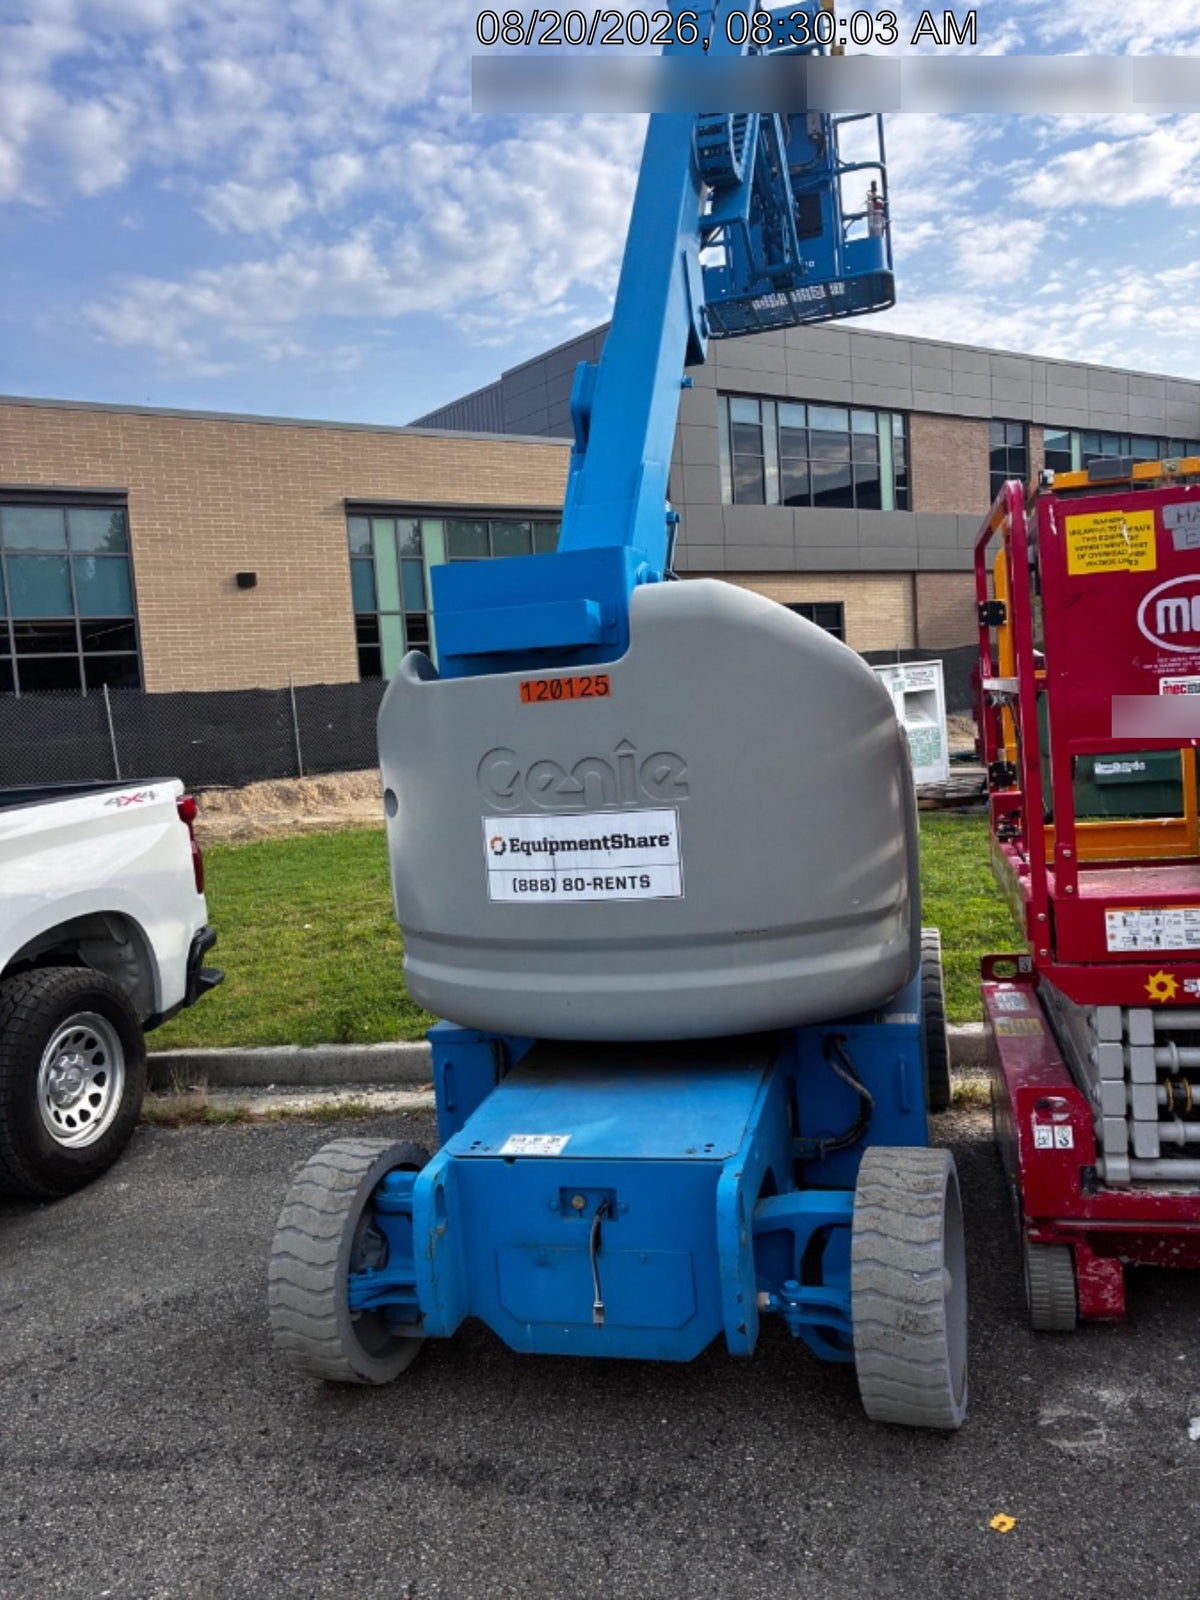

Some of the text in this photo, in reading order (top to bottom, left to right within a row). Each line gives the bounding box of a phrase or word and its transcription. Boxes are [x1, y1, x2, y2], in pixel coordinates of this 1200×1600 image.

[522, 675, 609, 701] 120125
[509, 833, 671, 856] EquipmentShare
[513, 874, 651, 892] (888) 80-RENTS
